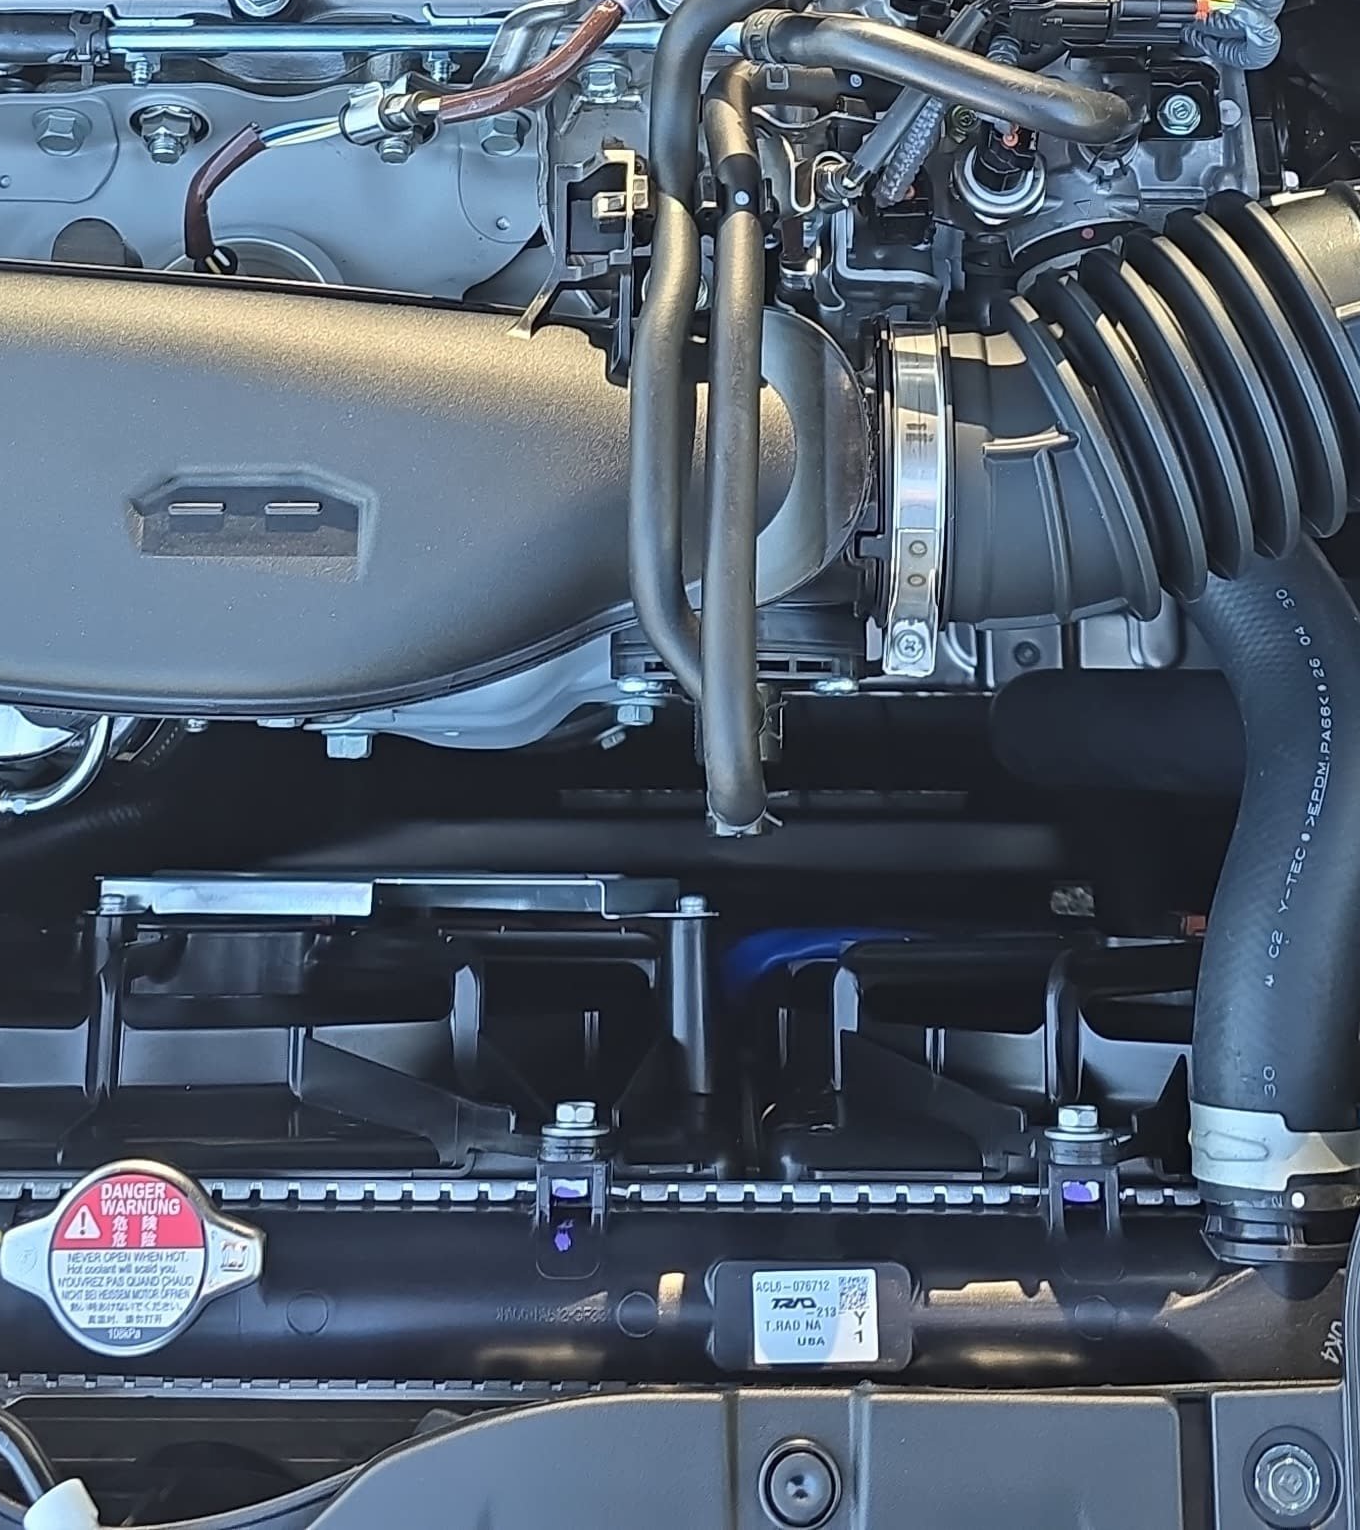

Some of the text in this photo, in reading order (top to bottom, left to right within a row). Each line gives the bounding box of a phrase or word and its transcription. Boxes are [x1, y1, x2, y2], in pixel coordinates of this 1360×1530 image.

[1275, 589, 1296, 610] 30
[1309, 657, 1326, 678] 26
[1278, 847, 1307, 913] Y-TEC
[1268, 930, 1284, 958] C2
[1263, 1066, 1277, 1098] 30
[101, 1182, 166, 1199] DANGER
[101, 1199, 181, 1216] WARNUNG
[68, 1252, 102, 1263] NEVER
[105, 1252, 132, 1263] OPEN
[134, 1252, 164, 1263] WHEN
[118, 1264, 133, 1274] will
[106, 1276, 125, 1287] PAS
[127, 1276, 159, 1287] QUAND
[84, 1290, 97, 1301] BEI
[132, 1290, 159, 1301] MOTOR
[854, 1310, 866, 1326] Y
[765, 1320, 822, 1333] T.RAD NA
[797, 1336, 825, 1346] USA
